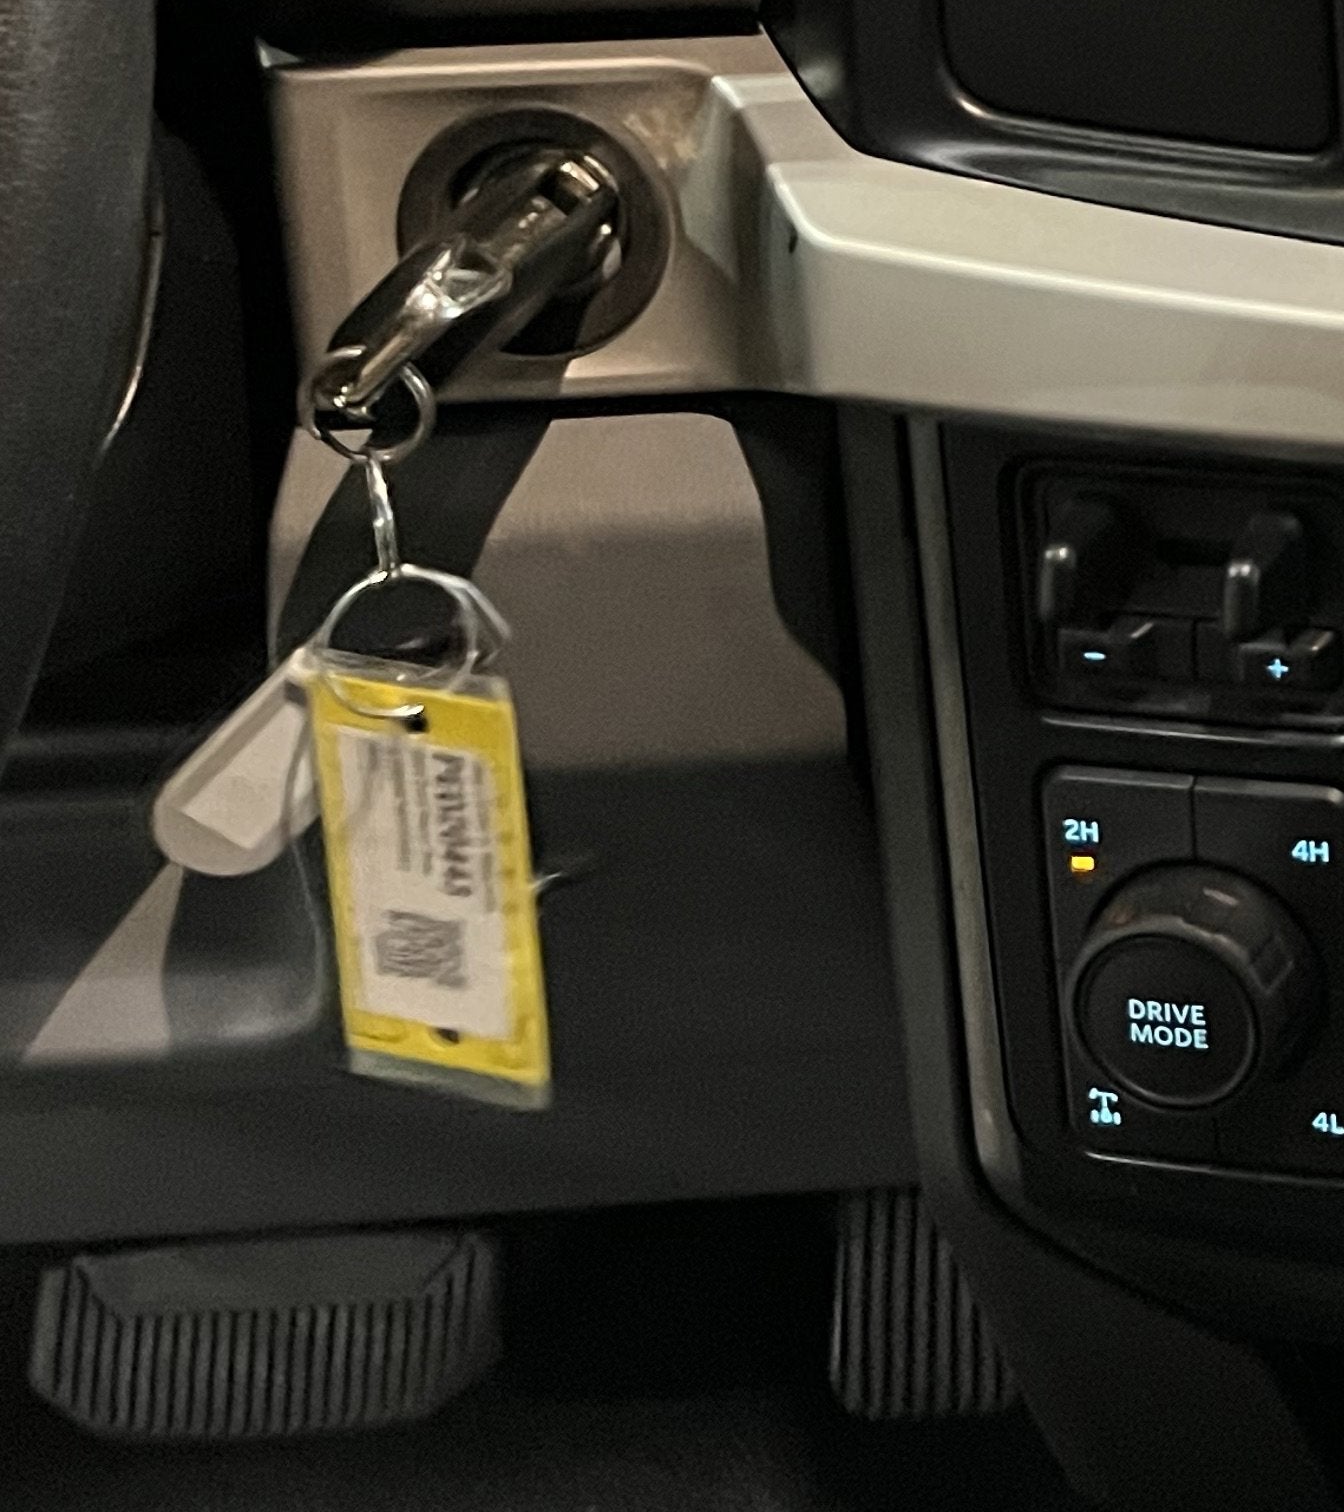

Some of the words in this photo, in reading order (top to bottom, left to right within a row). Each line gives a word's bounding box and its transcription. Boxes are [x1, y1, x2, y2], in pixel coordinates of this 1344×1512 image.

[1062, 818, 1099, 843] 2H
[1291, 839, 1330, 863] 4H
[1128, 998, 1206, 1026] DRIVE
[1130, 1023, 1209, 1050] MODE
